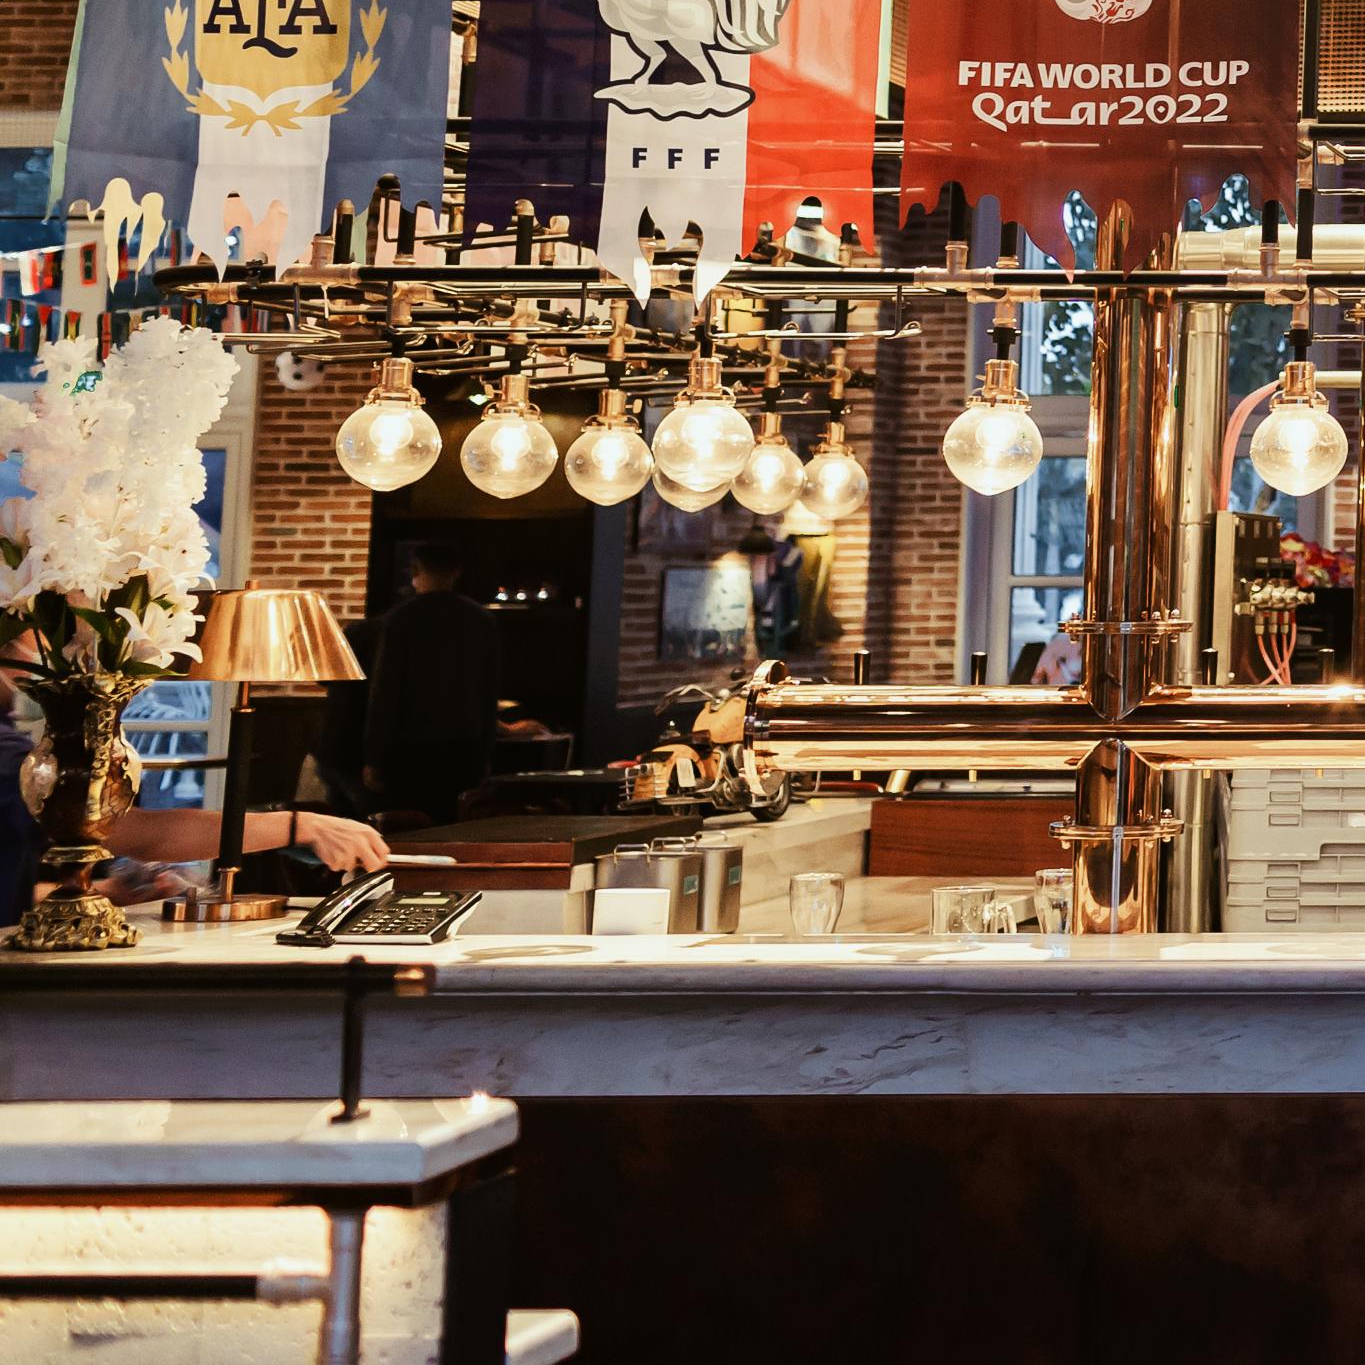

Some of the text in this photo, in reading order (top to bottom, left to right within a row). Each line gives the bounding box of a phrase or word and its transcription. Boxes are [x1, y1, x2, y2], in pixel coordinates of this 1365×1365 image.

[958, 60, 1250, 89] FIFA WORLD CUP
